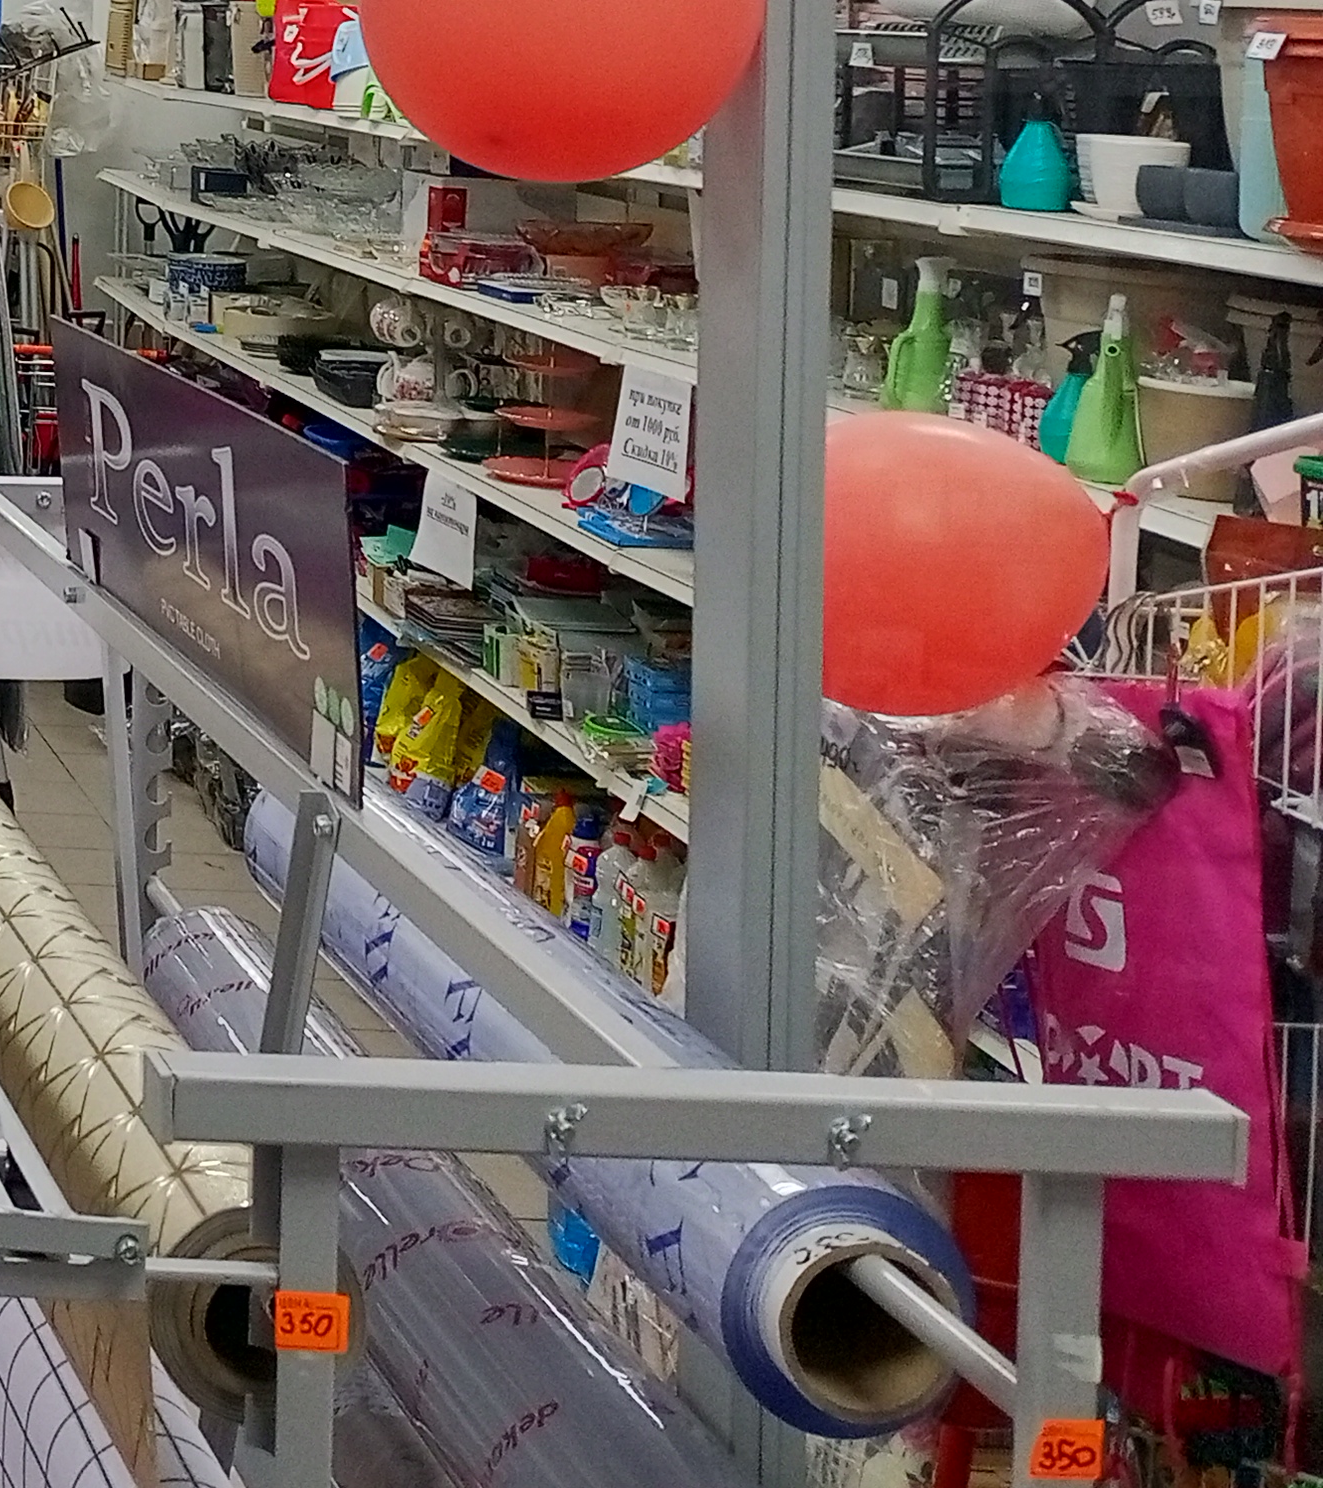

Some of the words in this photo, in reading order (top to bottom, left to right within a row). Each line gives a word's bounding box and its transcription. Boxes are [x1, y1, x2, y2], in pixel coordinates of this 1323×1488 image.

[80, 377, 311, 661] Perla
[280, 1312, 334, 1337] 350
[1038, 1438, 1097, 1472] 350
